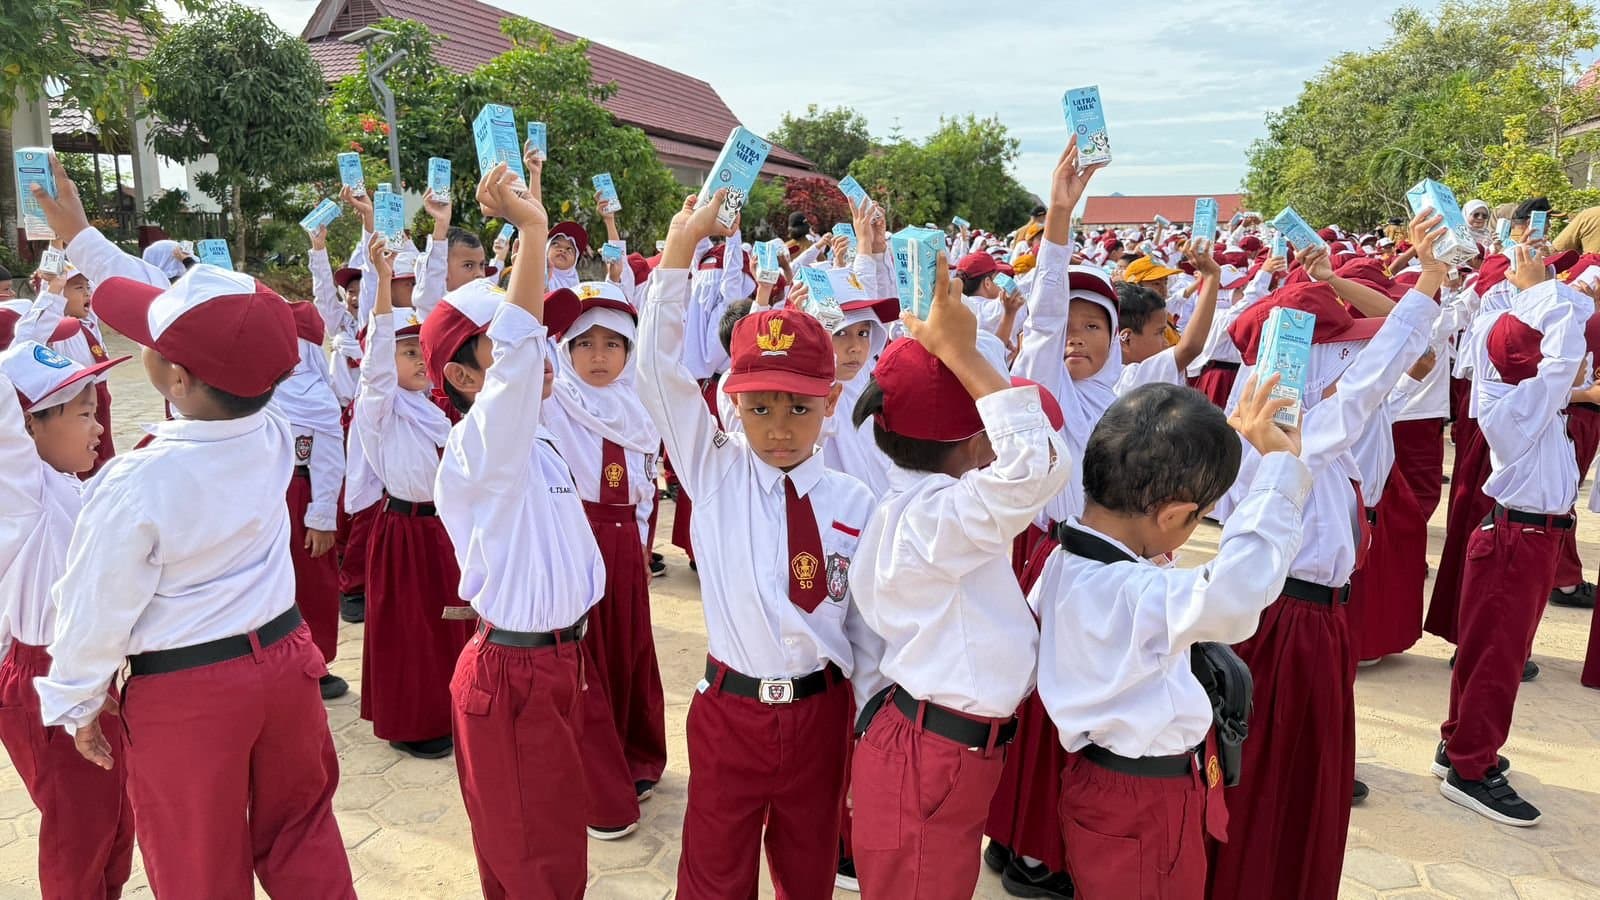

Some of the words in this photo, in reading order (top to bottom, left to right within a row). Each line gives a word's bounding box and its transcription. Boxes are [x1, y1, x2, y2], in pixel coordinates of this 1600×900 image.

[1072, 96, 1096, 106] ULTRA
[1077, 103, 1094, 112] MILK
[736, 141, 760, 161] ULTRA
[736, 150, 755, 166] MILK
[800, 580, 814, 590] SD
